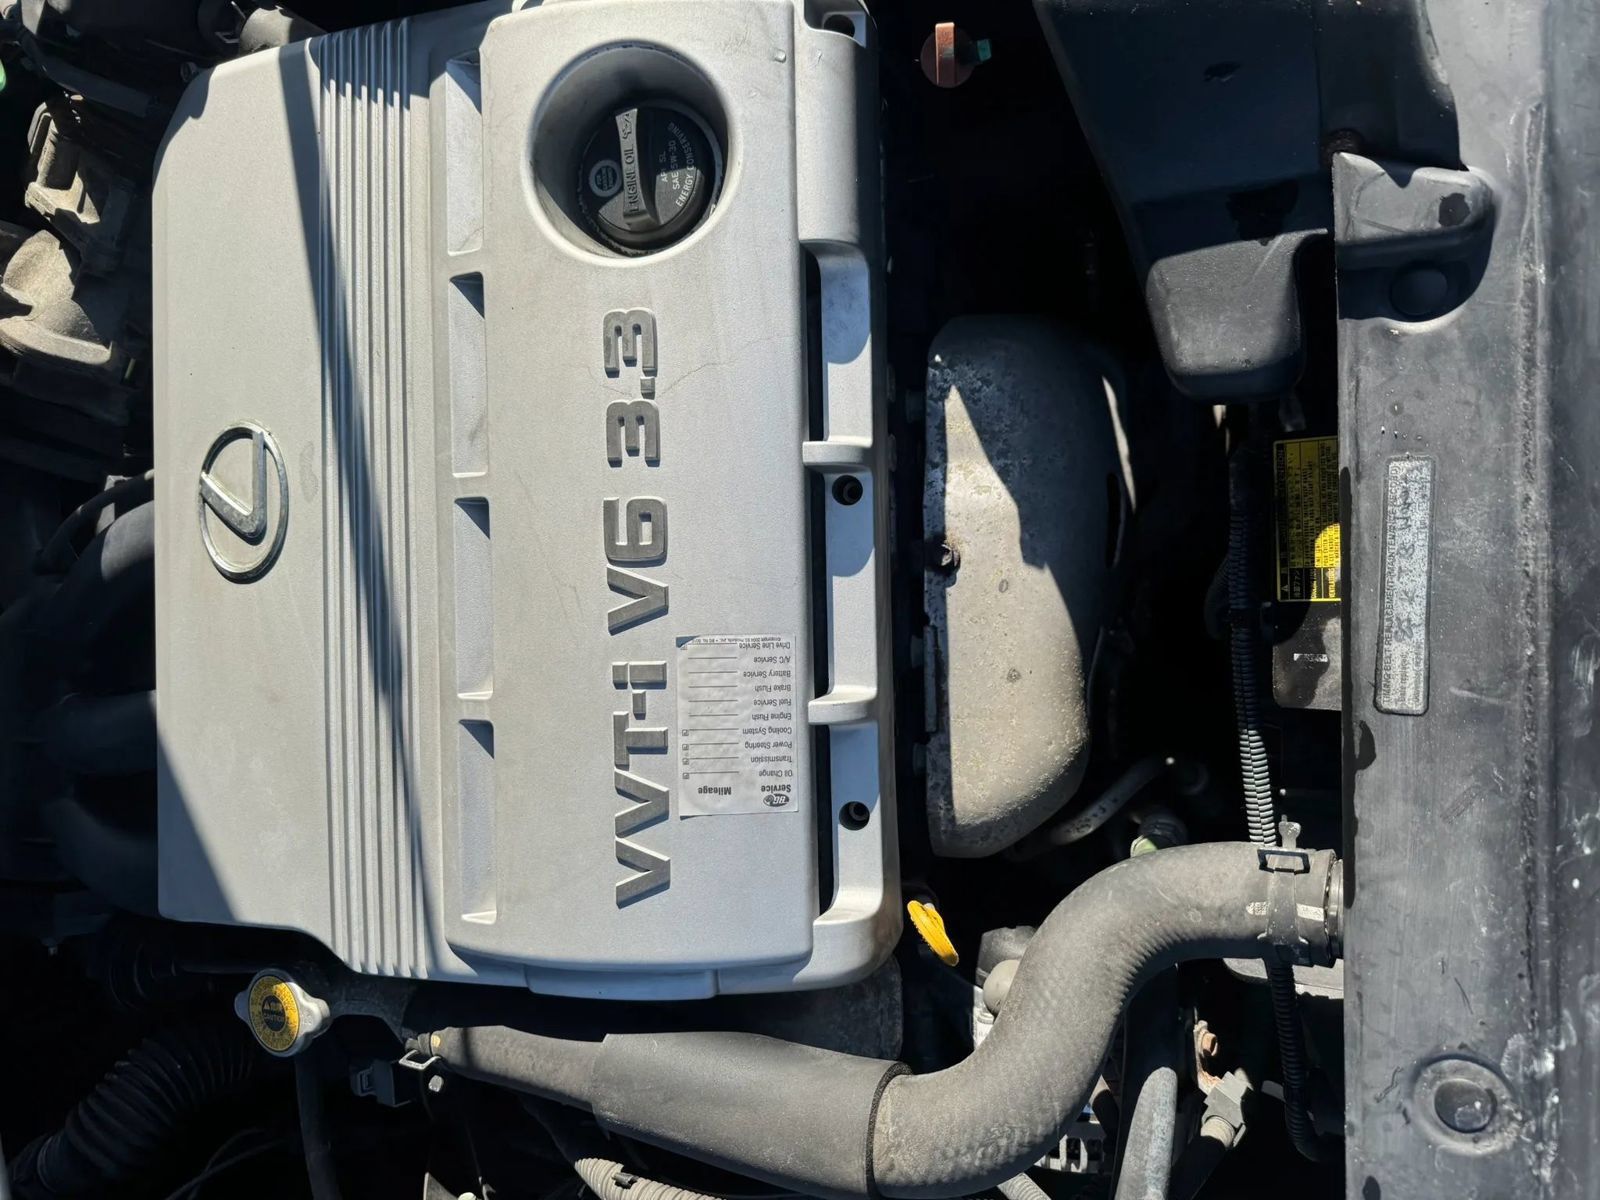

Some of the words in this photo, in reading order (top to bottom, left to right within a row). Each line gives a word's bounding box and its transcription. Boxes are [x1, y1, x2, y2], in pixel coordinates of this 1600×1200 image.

[624, 144, 634, 165] OIL
[668, 122, 695, 170] CONSERVING
[669, 140, 678, 169] 5W-30
[672, 172, 680, 190] SAE
[628, 168, 639, 213] ENGINE
[676, 174, 694, 207] ENERGY
[602, 309, 661, 468] 3.3
[602, 496, 669, 637] V6
[1384, 573, 1394, 645] REPLACEMENT
[753, 656, 777, 664] Service
[769, 669, 791, 677] Battery
[771, 712, 791, 720] Engine
[743, 727, 766, 735] System
[768, 726, 792, 734] Cooling
[745, 741, 770, 749] Steering
[759, 769, 782, 777] Change
[611, 659, 672, 910] VVT-i
[698, 787, 732, 795] Mileage
[761, 784, 791, 793] Service
